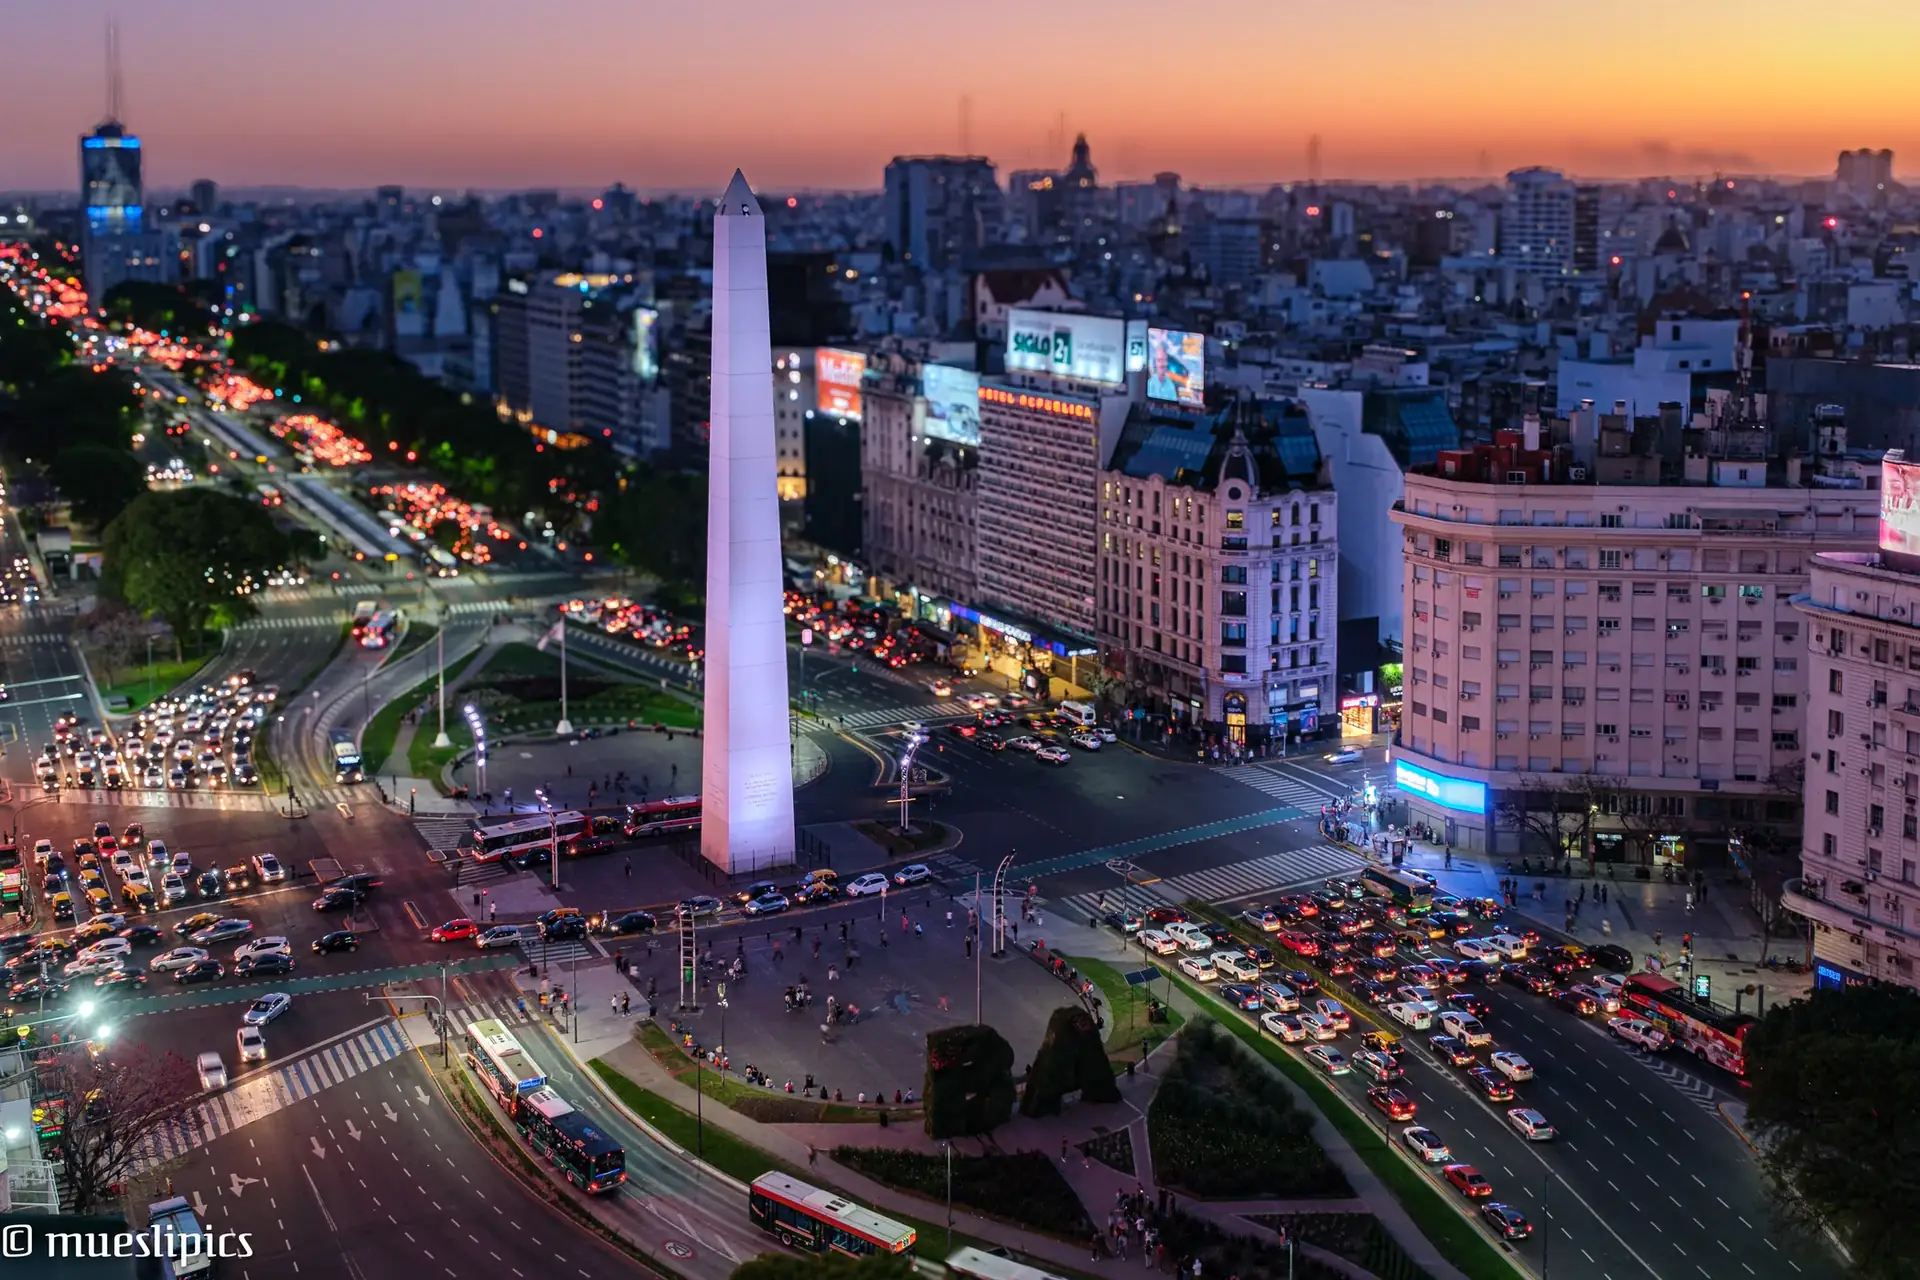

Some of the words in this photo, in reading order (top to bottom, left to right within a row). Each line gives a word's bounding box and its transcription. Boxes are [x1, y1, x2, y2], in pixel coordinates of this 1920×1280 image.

[1014, 330, 1051, 356] SIGLO
[978, 387, 1015, 404] HOTEL
[1019, 394, 1092, 418] REPUBLICA
